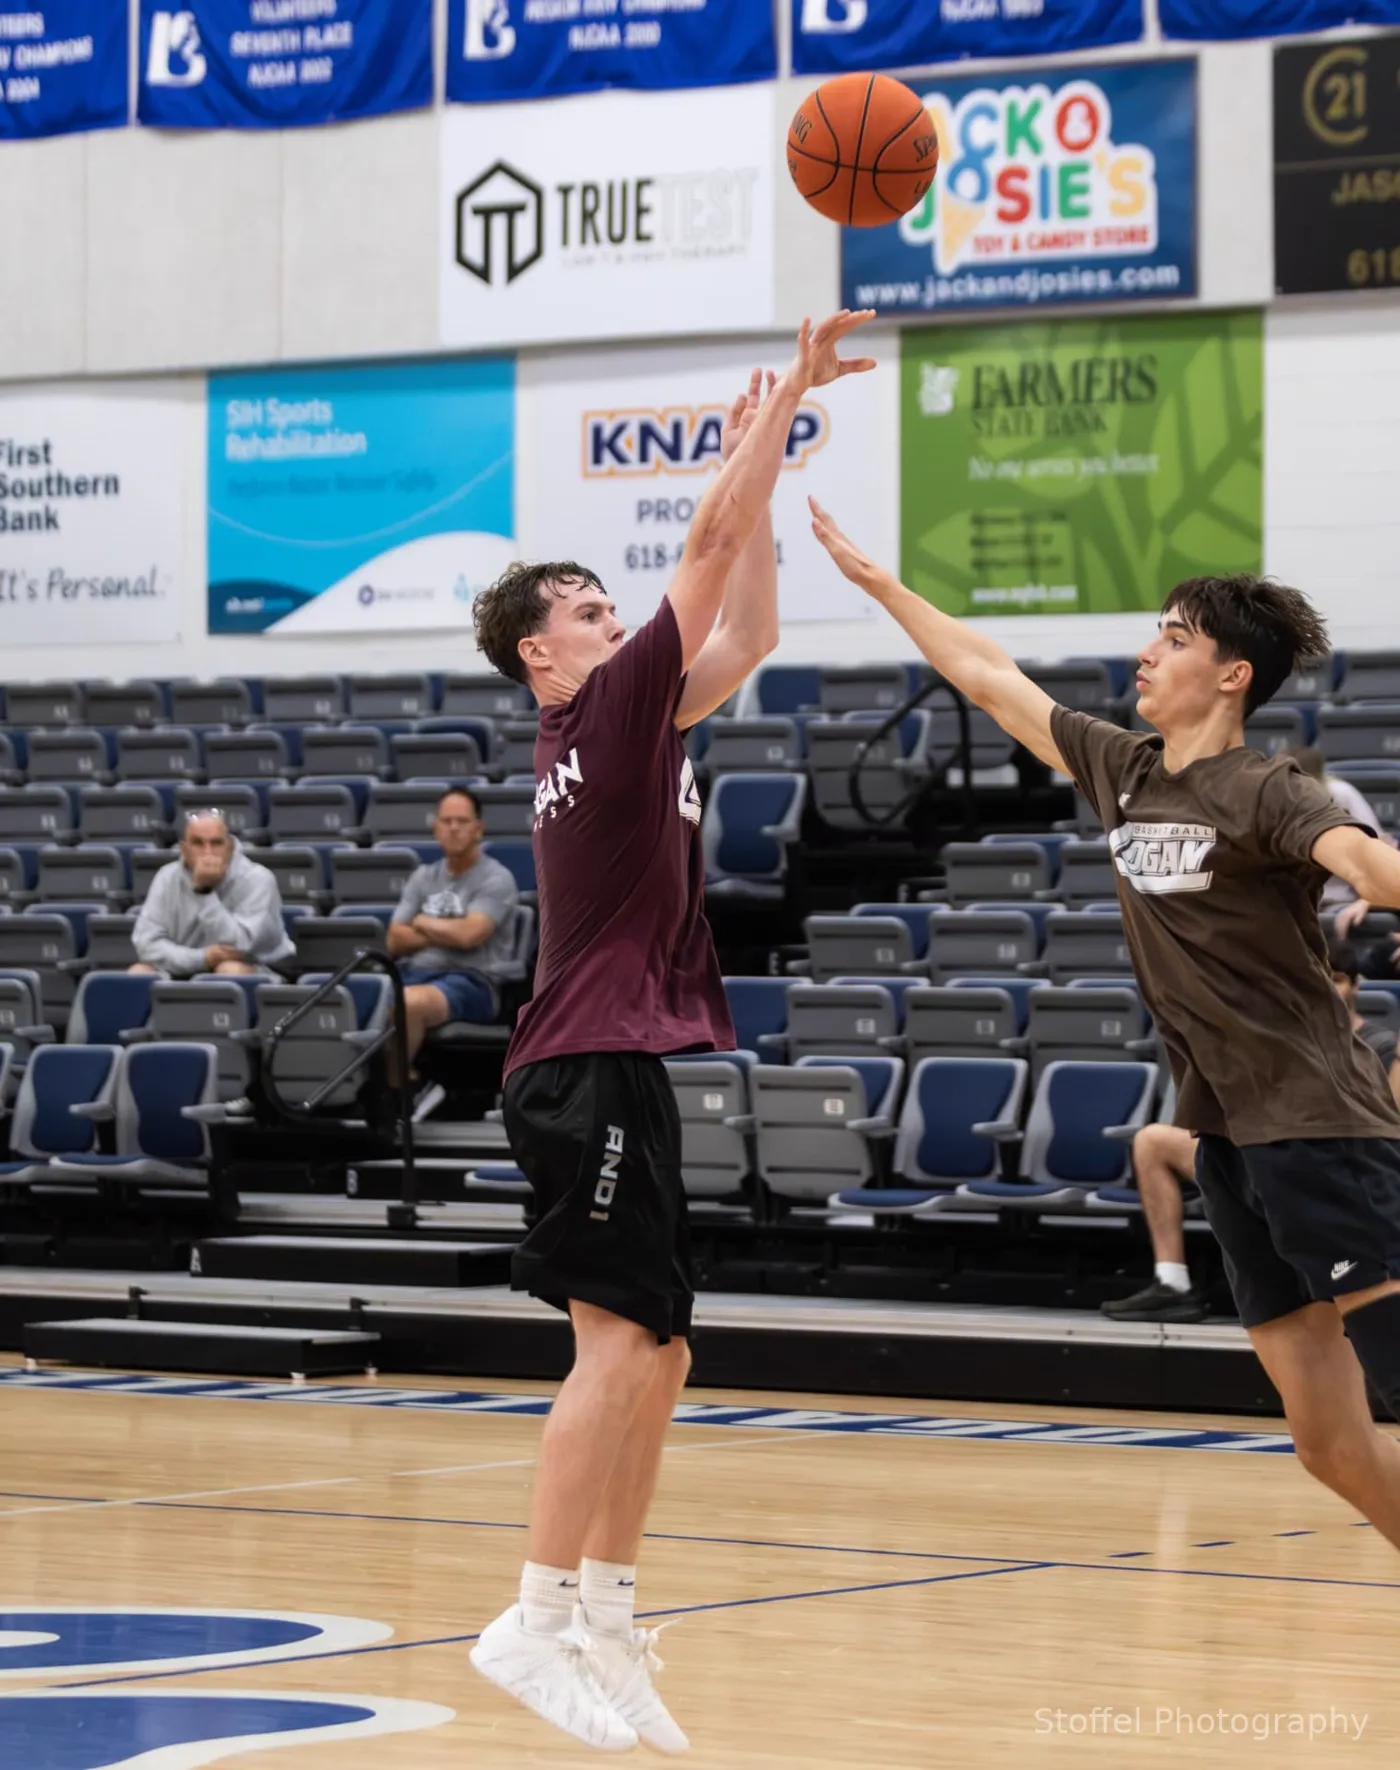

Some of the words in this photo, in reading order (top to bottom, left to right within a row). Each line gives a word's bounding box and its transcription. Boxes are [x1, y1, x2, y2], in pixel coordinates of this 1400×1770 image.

[973, 235, 1003, 254] TOY
[1026, 230, 1086, 251] CANDY
[1094, 225, 1151, 247] STORE
[855, 263, 1180, 304] www.jackandjosies.com
[971, 355, 1157, 411] FARMERS
[266, 397, 332, 428] Sports
[226, 428, 367, 461] Rehabilitation
[591, 410, 819, 465] KNAP
[0, 472, 120, 499] Southern
[1133, 823, 1213, 837] BASKETBALL
